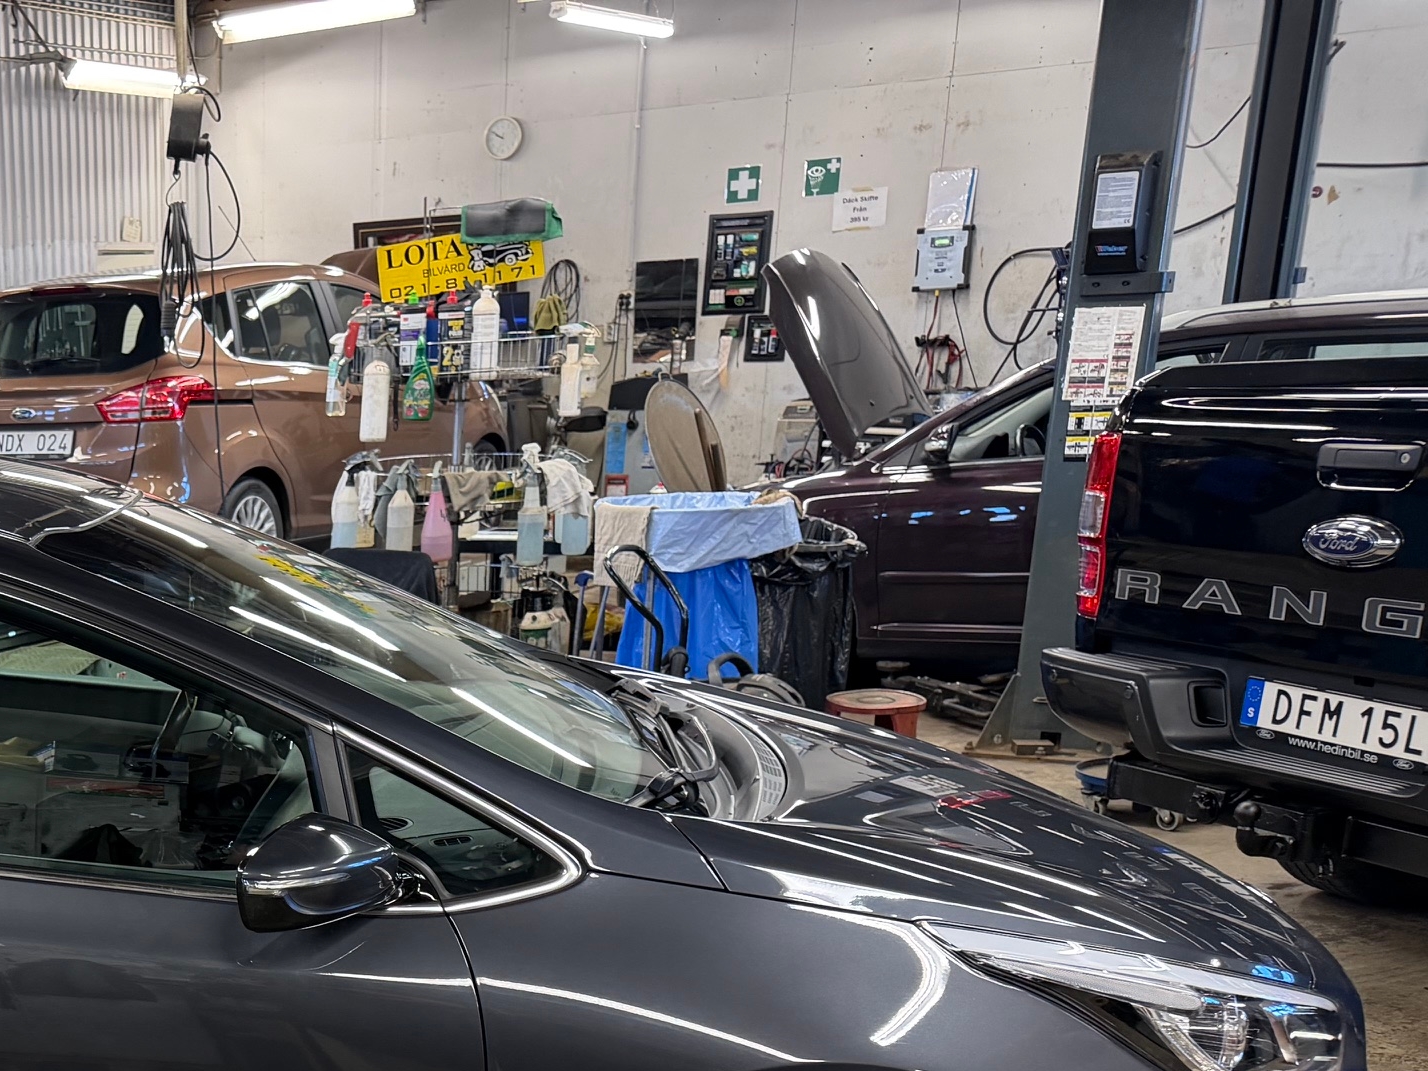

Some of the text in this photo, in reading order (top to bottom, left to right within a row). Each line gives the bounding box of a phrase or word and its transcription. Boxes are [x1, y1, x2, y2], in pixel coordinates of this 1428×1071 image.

[860, 195, 879, 203] Skifte
[384, 238, 465, 271] LOTA
[422, 263, 466, 279] BILVÅRD
[37, 433, 67, 452] 024
[1318, 532, 1361, 552] Ford
[1115, 568, 1426, 639] RANG
[1247, 707, 1255, 718] S
[1271, 688, 1423, 757] DFM 15L
[1257, 729, 1274, 739] Ford
[1288, 736, 1378, 764] www.hedinbil.se
